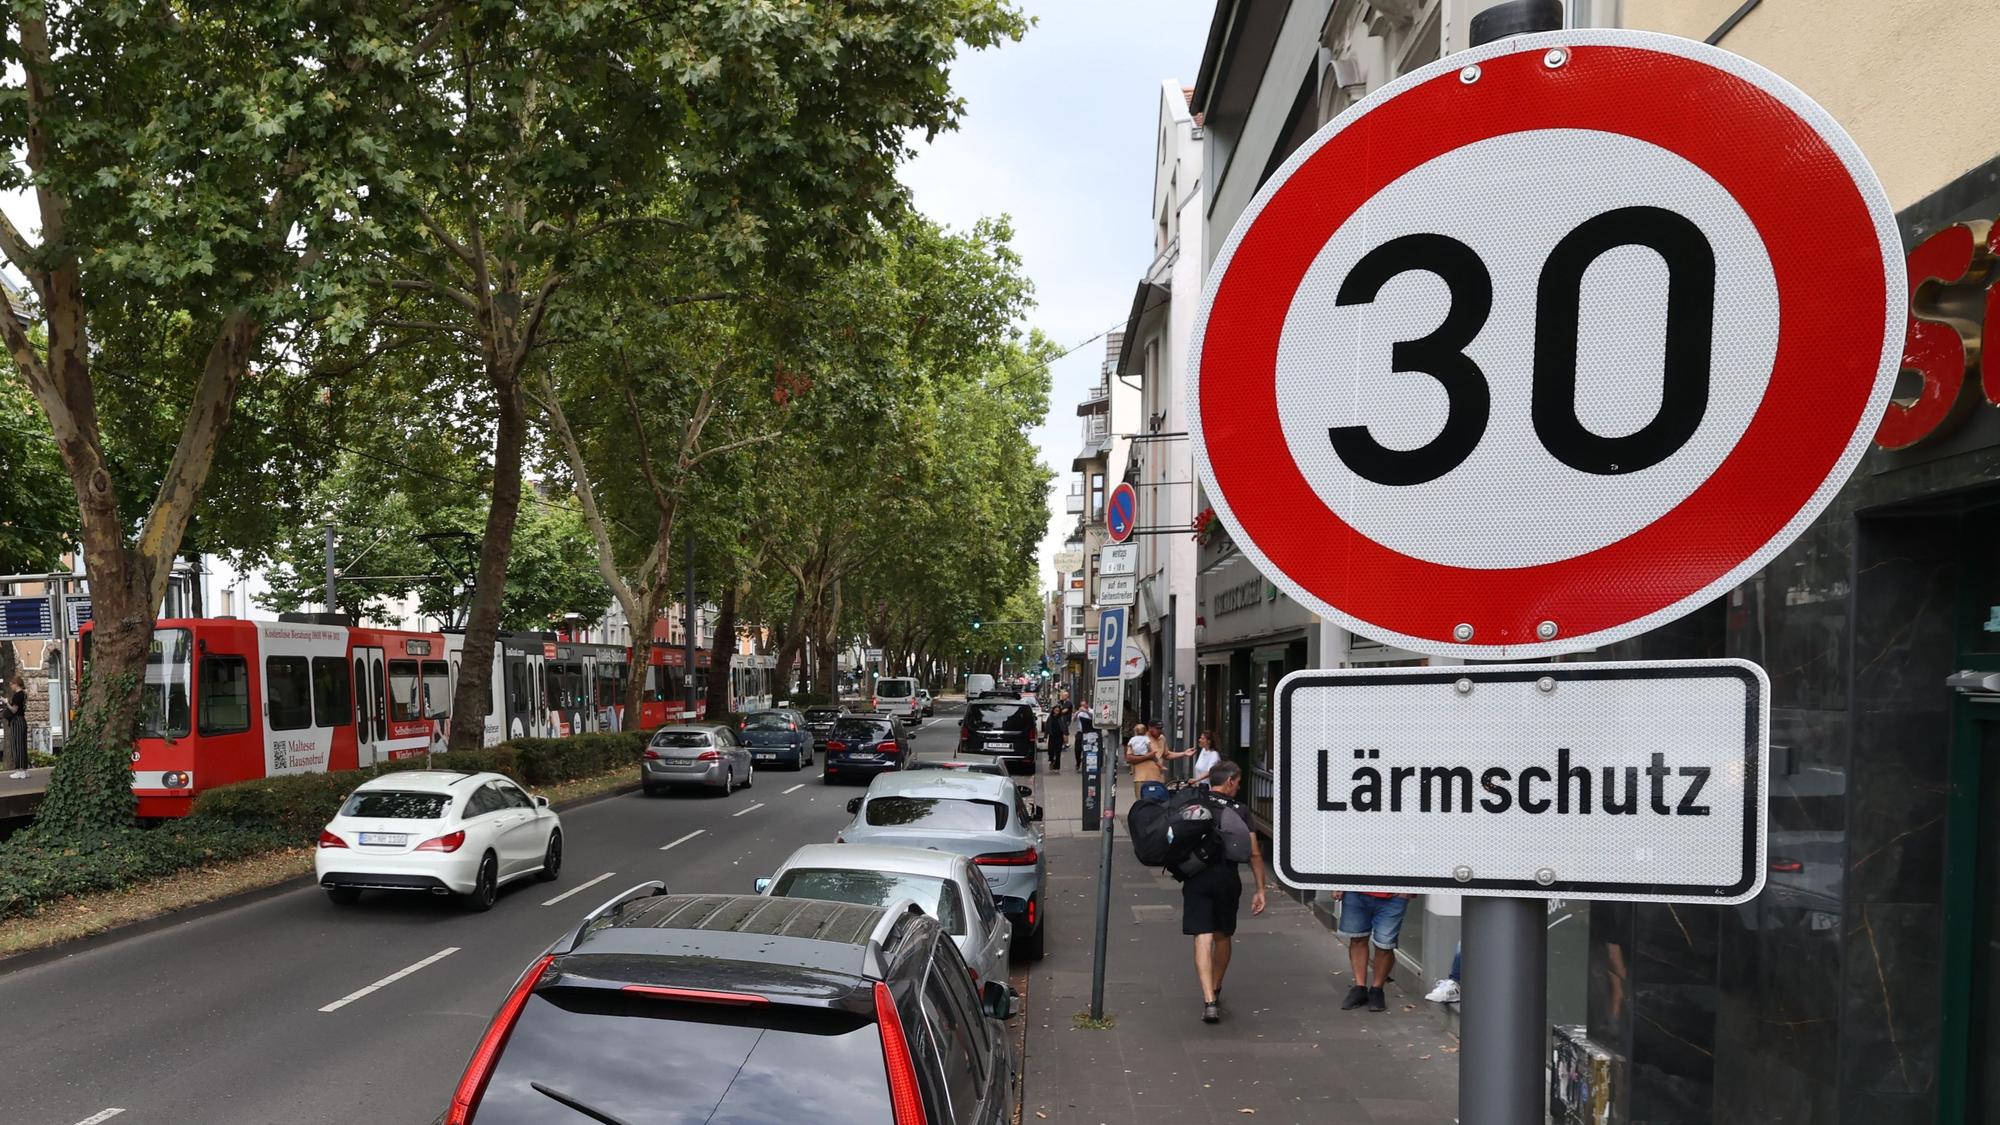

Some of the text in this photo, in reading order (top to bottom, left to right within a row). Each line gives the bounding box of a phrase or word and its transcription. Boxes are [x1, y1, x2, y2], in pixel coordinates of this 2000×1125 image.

[1873, 214, 2000, 450] S
[1328, 205, 1715, 486] 30
[1117, 580, 1127, 589] dem
[1101, 591, 1133, 601] Seitenstreifen
[264, 628, 290, 639] Kostenlose
[291, 630, 311, 643] Beratung
[1102, 616, 1118, 668] P
[288, 740, 316, 752] Malteser
[288, 752, 325, 768] Hausnotruf
[1316, 748, 1711, 816] Lärmschutz
